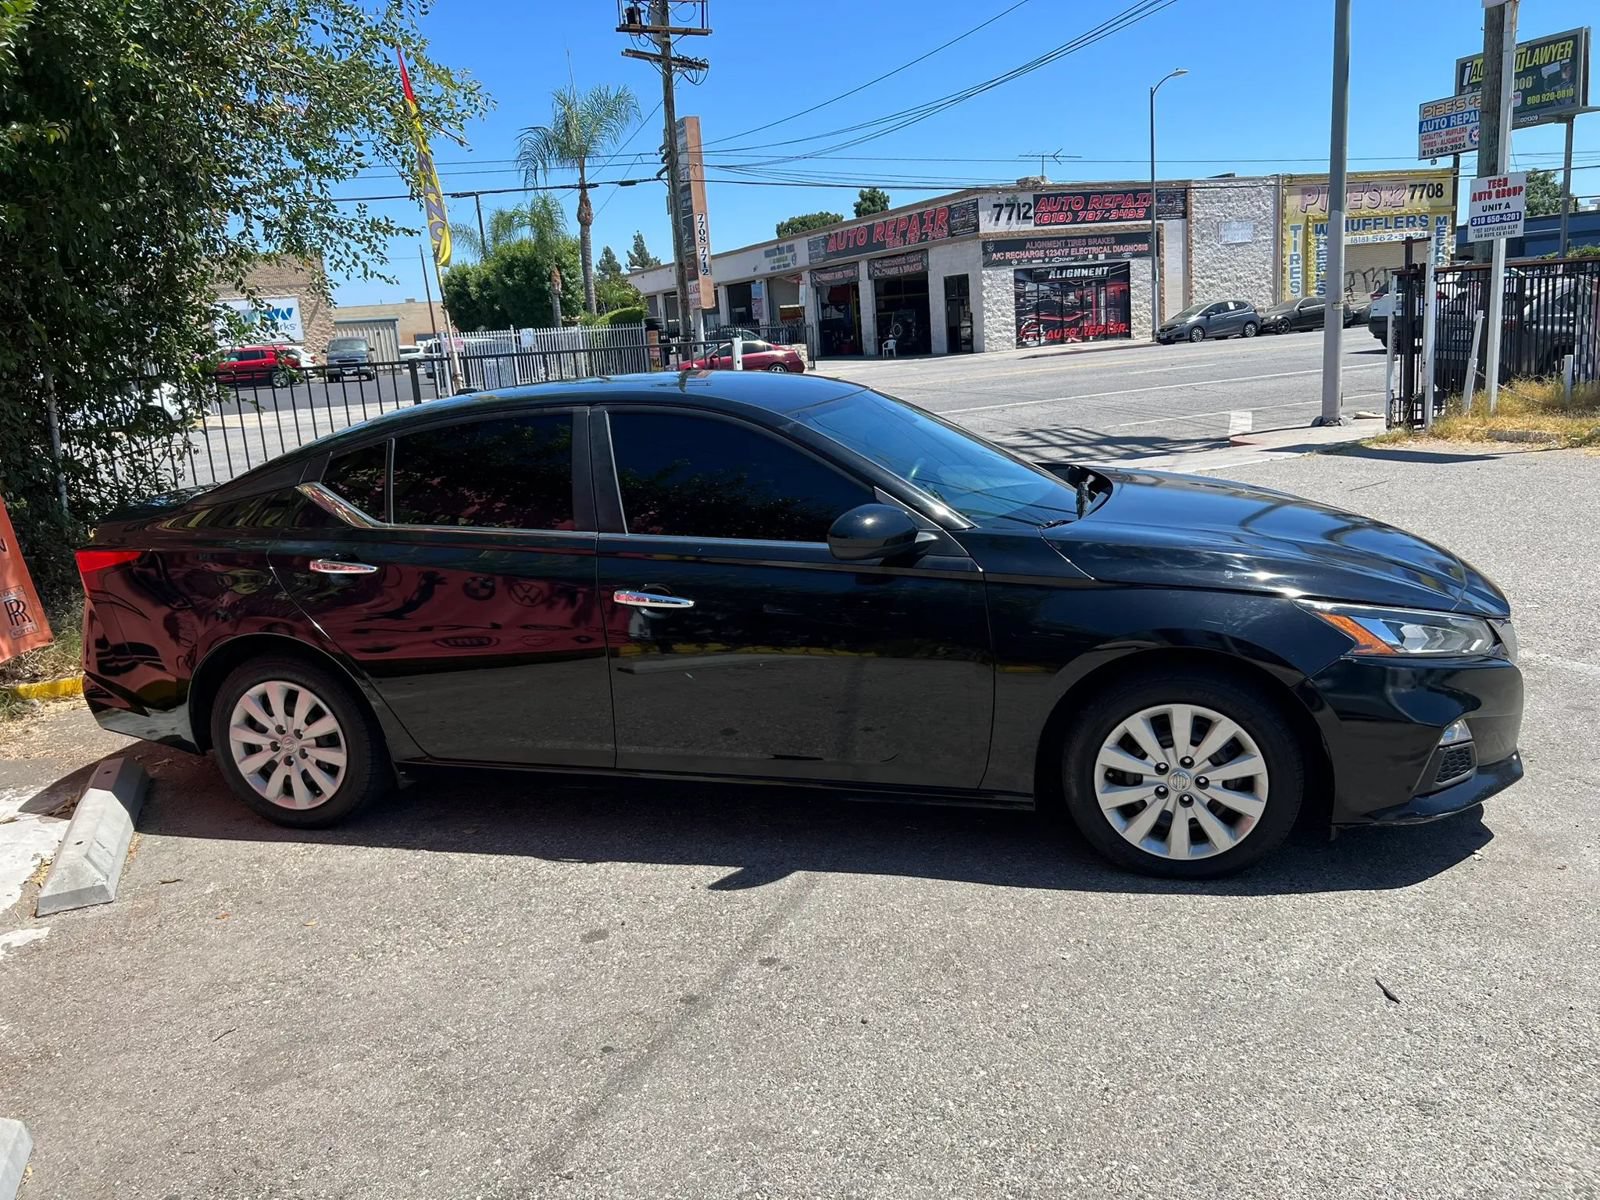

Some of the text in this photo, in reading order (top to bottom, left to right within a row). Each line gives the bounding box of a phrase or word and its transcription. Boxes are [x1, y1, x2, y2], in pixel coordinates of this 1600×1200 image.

[1525, 39, 1574, 68] LAWYER
[1422, 110, 1480, 133] AUTO REPAI
[1409, 182, 1444, 201] 7708
[1487, 177, 1509, 190] TECH
[1034, 194, 1084, 213] AUTO
[1471, 186, 1524, 203] AUTO GROUP
[992, 201, 1034, 222] 7712
[1481, 202, 1511, 213] UNIT A
[1034, 210, 1073, 225] (818)
[1486, 212, 1520, 224] 650-4201
[697, 213, 706, 244] 7708
[827, 226, 868, 253] AUTO
[873, 207, 949, 243] REPAIR
[1005, 250, 1045, 260] RECHARGE
[1070, 246, 1112, 256] ELECTRICAL
[1113, 243, 1149, 254] DIAGNOSIS
[1025, 236, 1116, 250] ALIGNMENT TIRES BRAKES
[700, 246, 709, 276] 7712
[1289, 225, 1302, 294] TIRES
[1048, 266, 1110, 280] ALIGNMENT
[1045, 327, 1079, 340] AUTO
